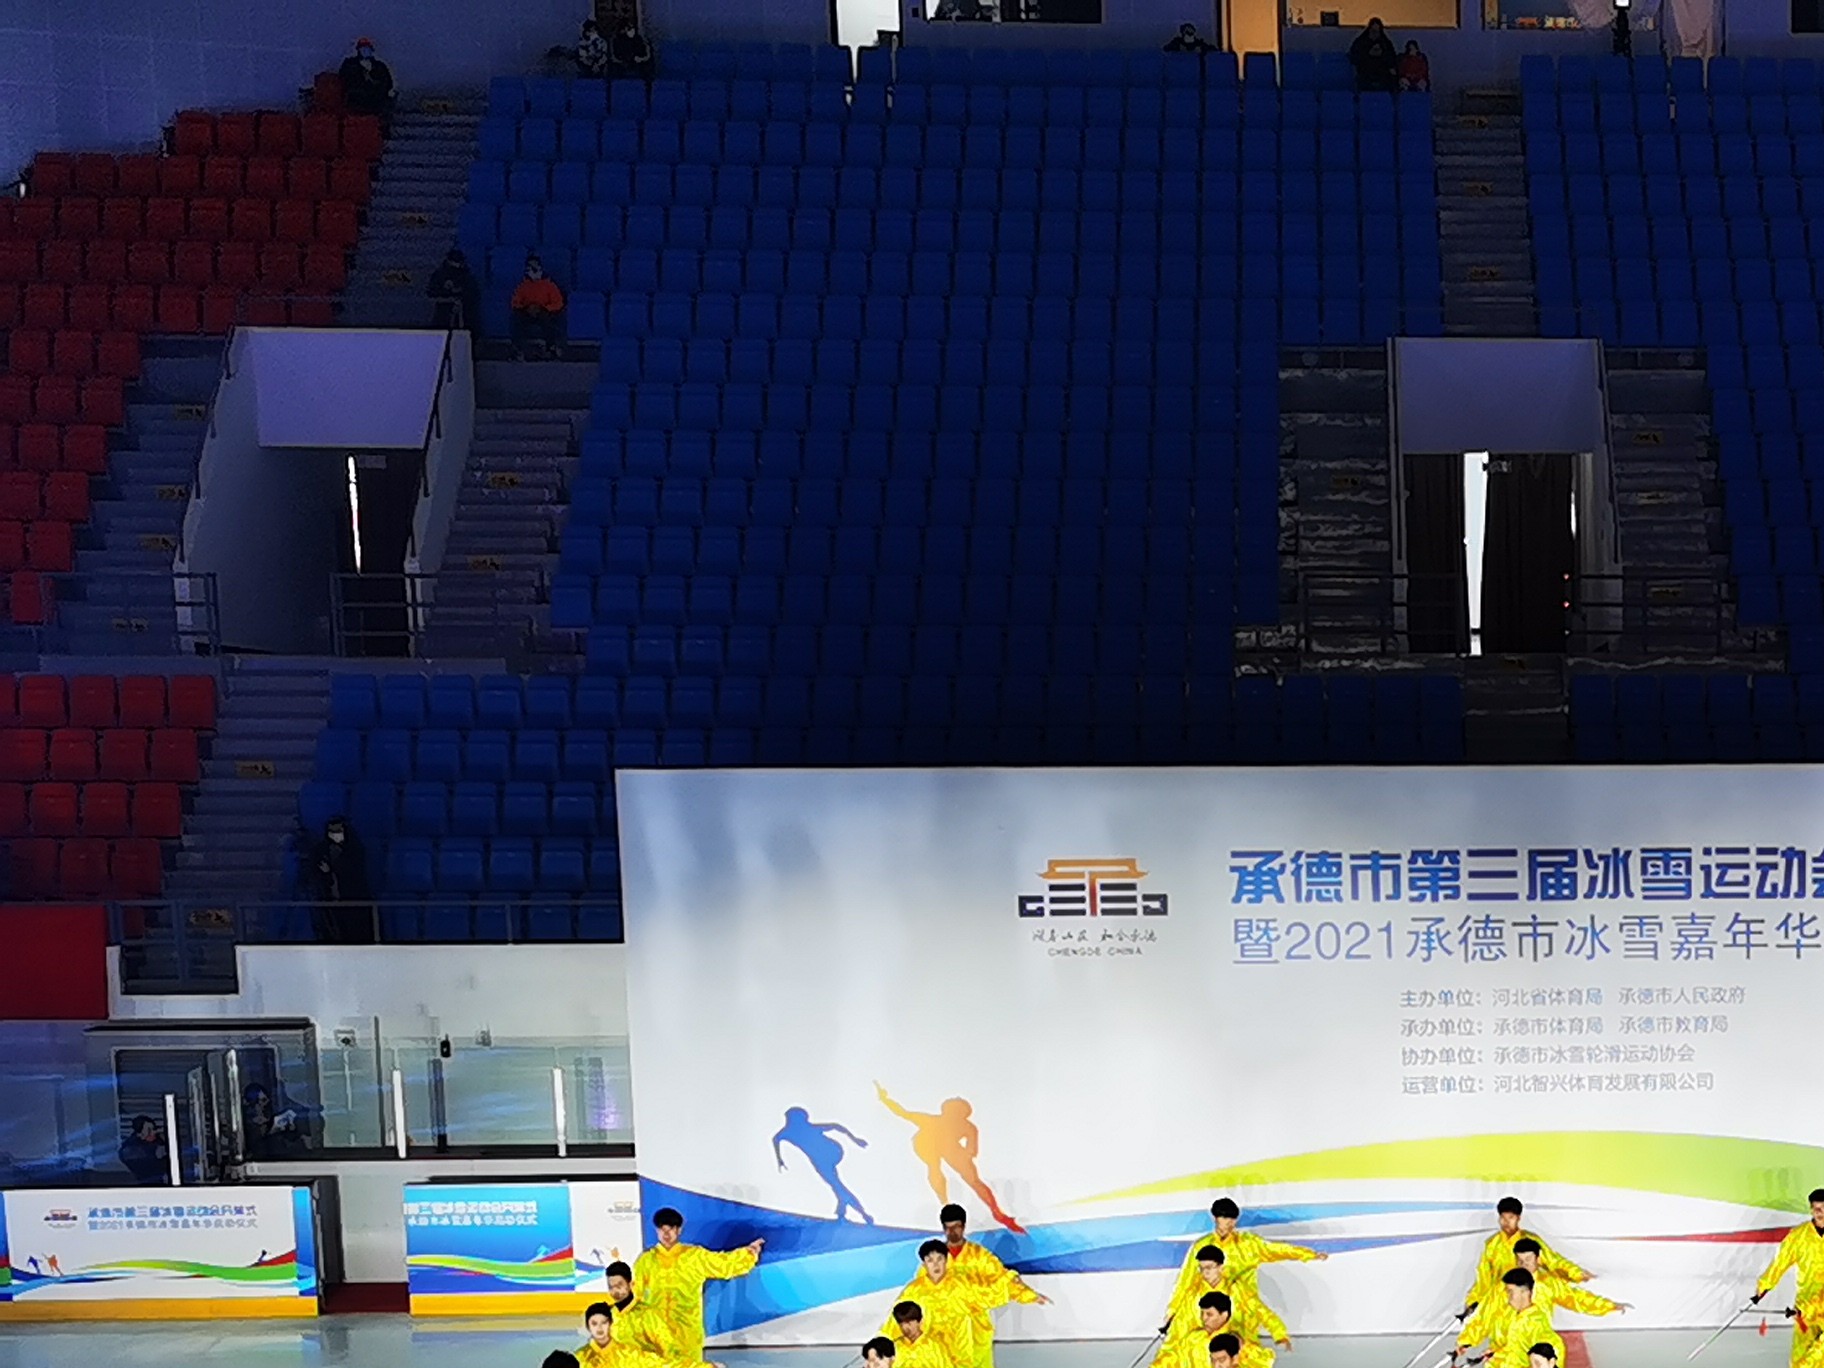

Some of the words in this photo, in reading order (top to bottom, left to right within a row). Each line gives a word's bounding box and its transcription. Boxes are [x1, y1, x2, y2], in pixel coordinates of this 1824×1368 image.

[1619, 985, 1746, 1006] 承德市人民政府
[1619, 1014, 1729, 1035] 承德市教育局
